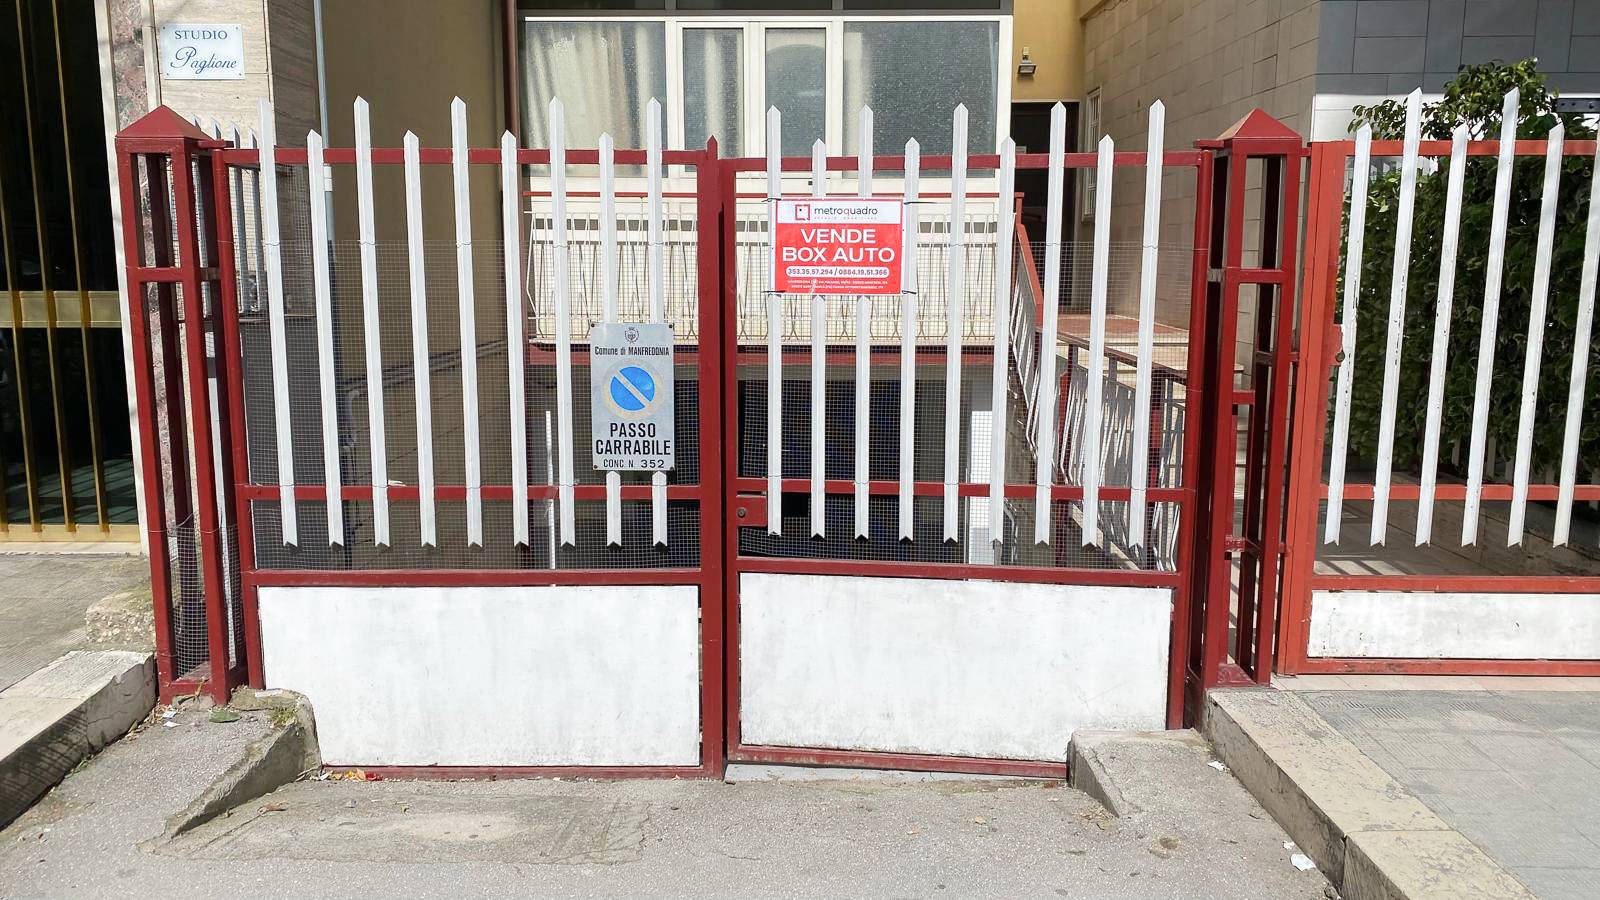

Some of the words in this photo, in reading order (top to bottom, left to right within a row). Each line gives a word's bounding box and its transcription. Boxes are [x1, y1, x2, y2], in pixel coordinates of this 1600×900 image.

[174, 30, 228, 40] STUDIO
[170, 46, 237, 74] Paglione
[814, 206, 878, 216] metroquadro
[800, 228, 877, 244] VENDE
[782, 247, 827, 262] BOX
[832, 247, 895, 263] AUTO
[594, 346, 618, 356] Comune
[620, 346, 626, 356] di
[628, 346, 670, 356] MANFREDONIA
[610, 422, 656, 438] PASSO
[595, 440, 671, 456] CARRABILE
[640, 459, 665, 469] 352
